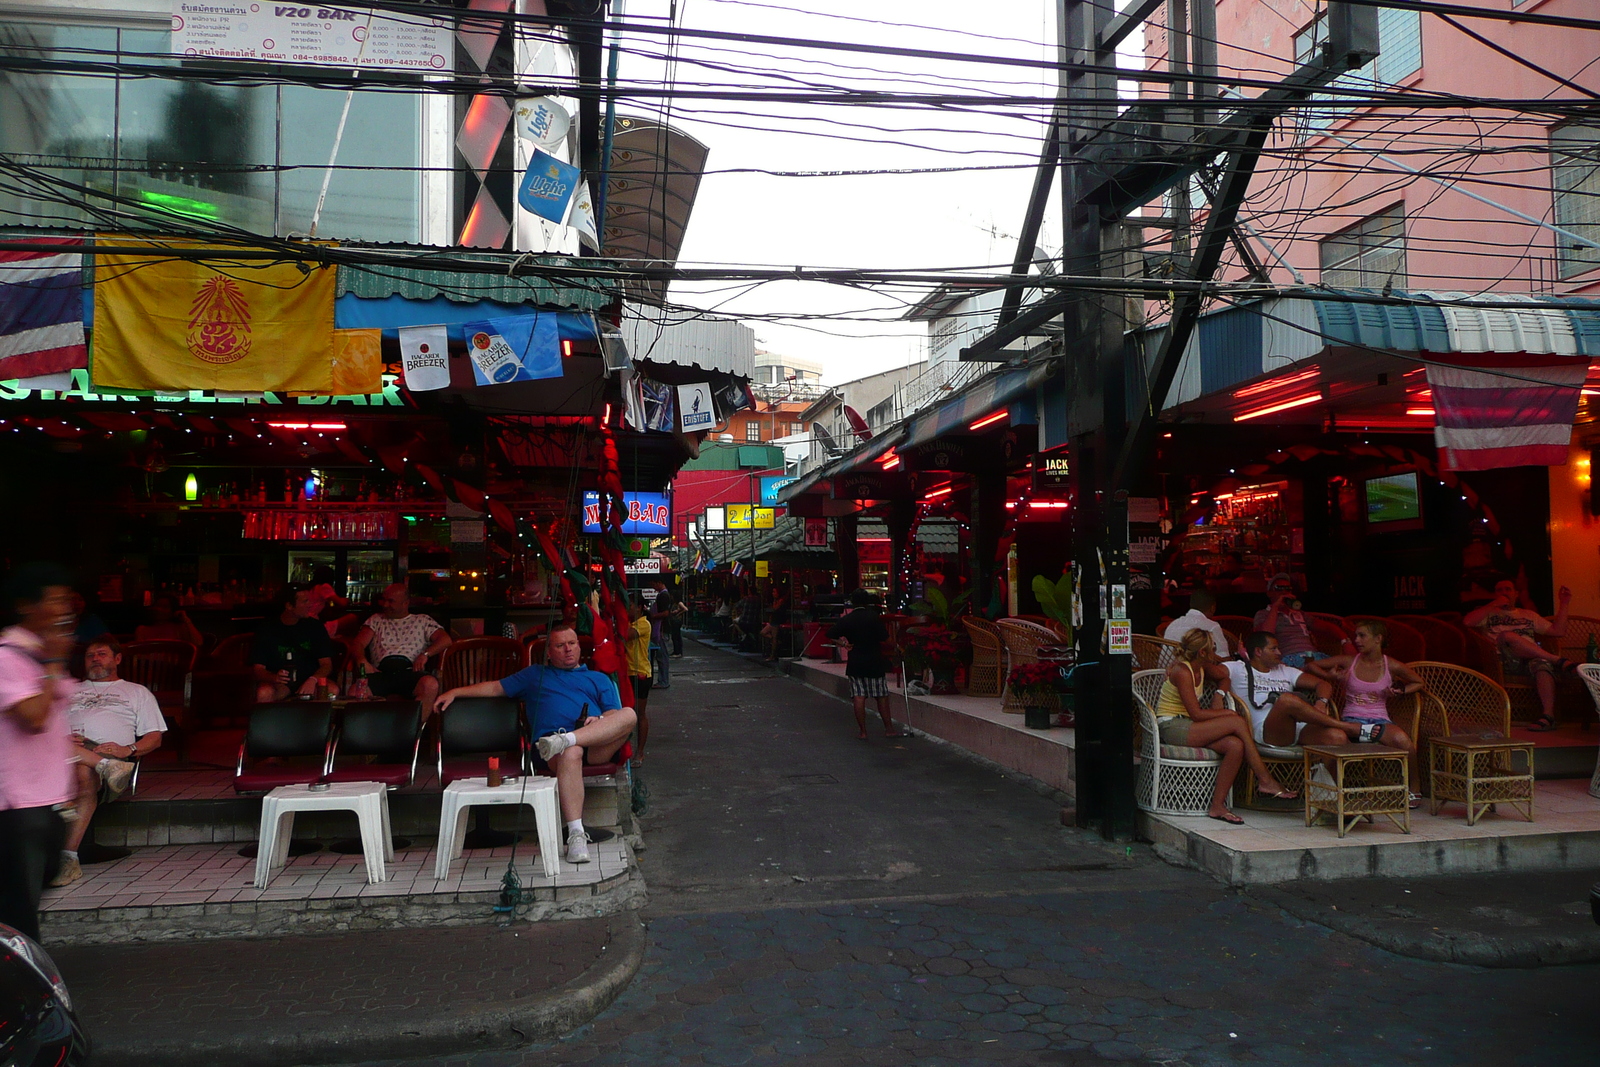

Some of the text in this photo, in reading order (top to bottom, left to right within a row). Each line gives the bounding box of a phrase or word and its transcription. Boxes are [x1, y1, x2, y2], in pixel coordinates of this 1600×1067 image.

[274, 6, 358, 21] V20 BAR
[527, 104, 549, 139] Light
[527, 174, 567, 197] Light
[406, 358, 447, 372] BREEZER
[410, 352, 440, 360] BACARDI
[1045, 458, 1069, 471] JACK
[628, 500, 669, 527] BAR
[1393, 575, 1426, 598] JACK
